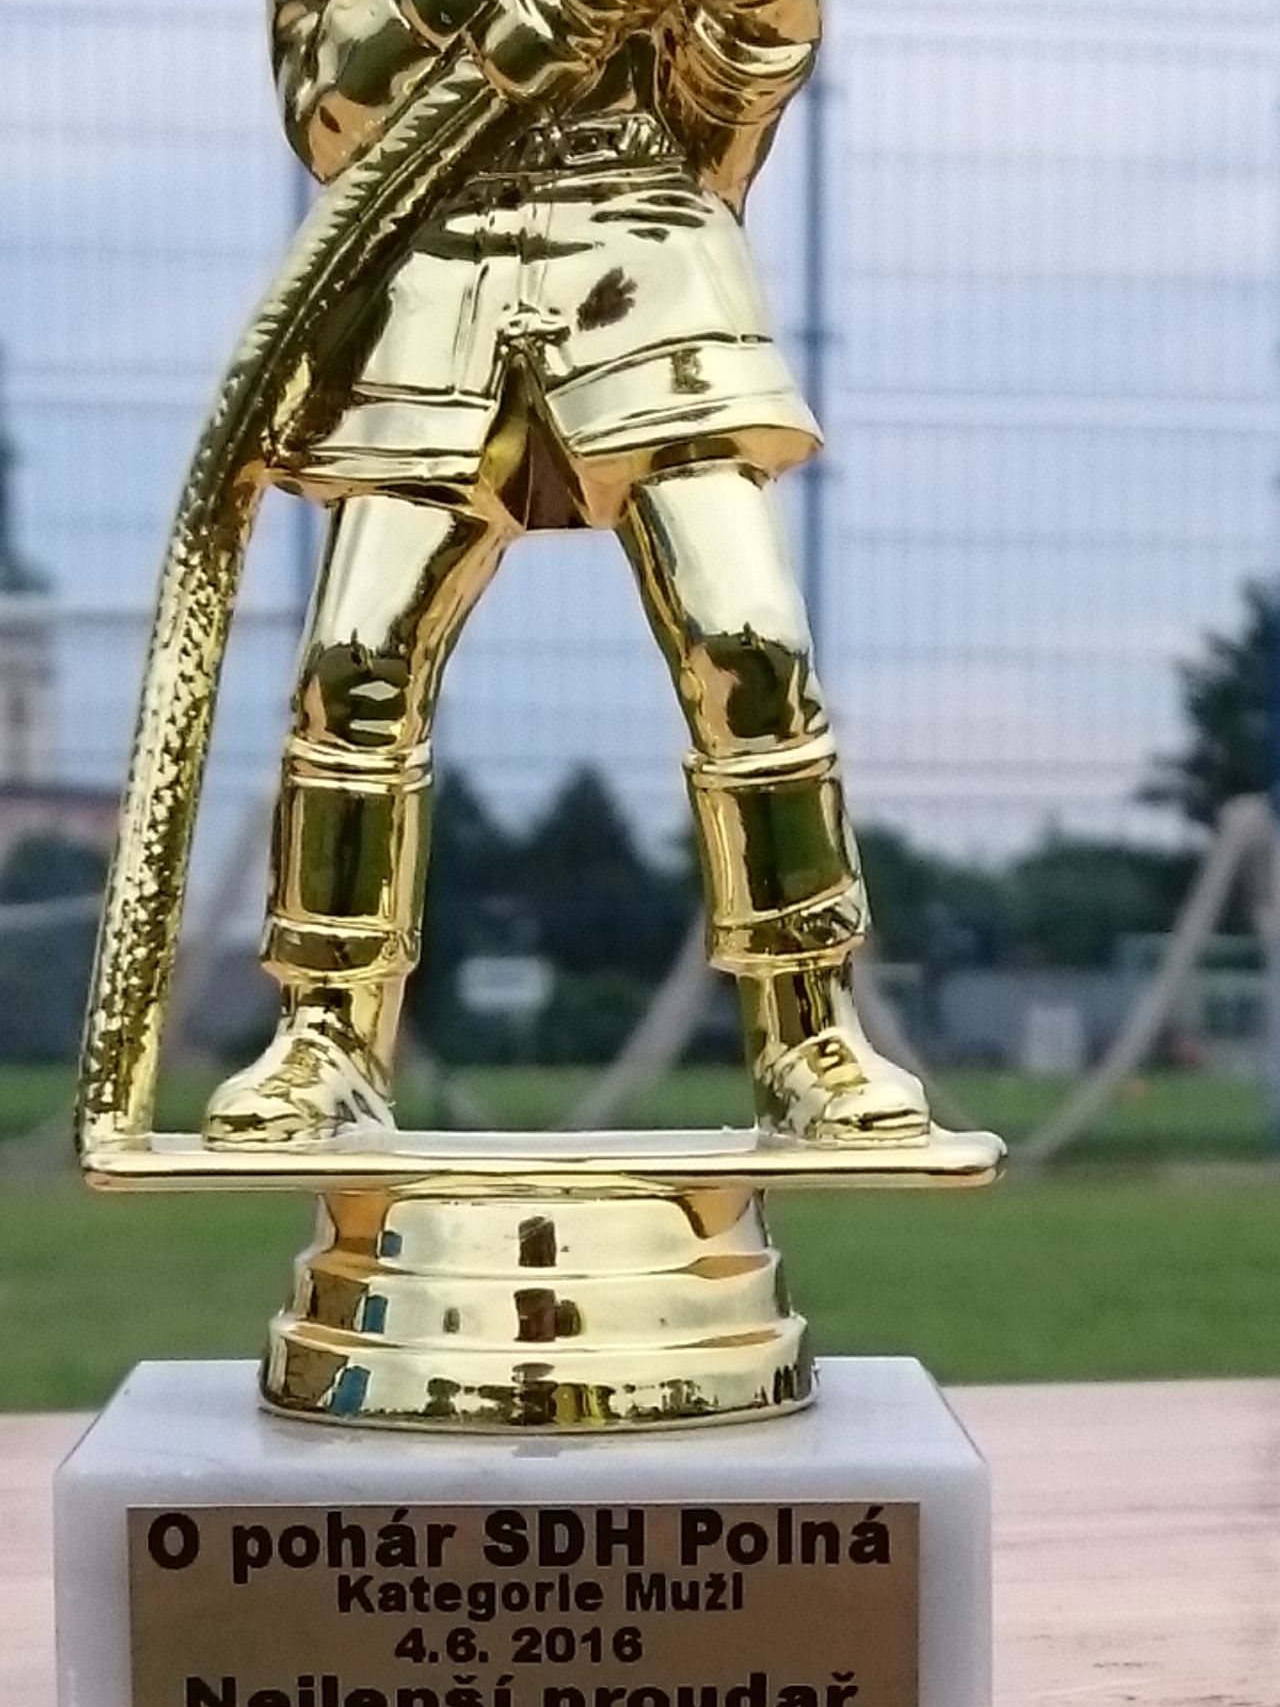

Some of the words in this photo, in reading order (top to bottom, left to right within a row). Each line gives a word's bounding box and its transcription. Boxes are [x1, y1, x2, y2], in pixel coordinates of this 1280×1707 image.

[147, 1511, 201, 1571] O
[231, 1508, 458, 1585] pohár
[482, 1508, 645, 1569] SDH
[680, 1505, 891, 1567] Polná
[337, 1572, 605, 1624] Kategorie
[625, 1571, 745, 1614] Muži
[393, 1626, 490, 1665] 4.6.
[510, 1625, 644, 1664] 2016
